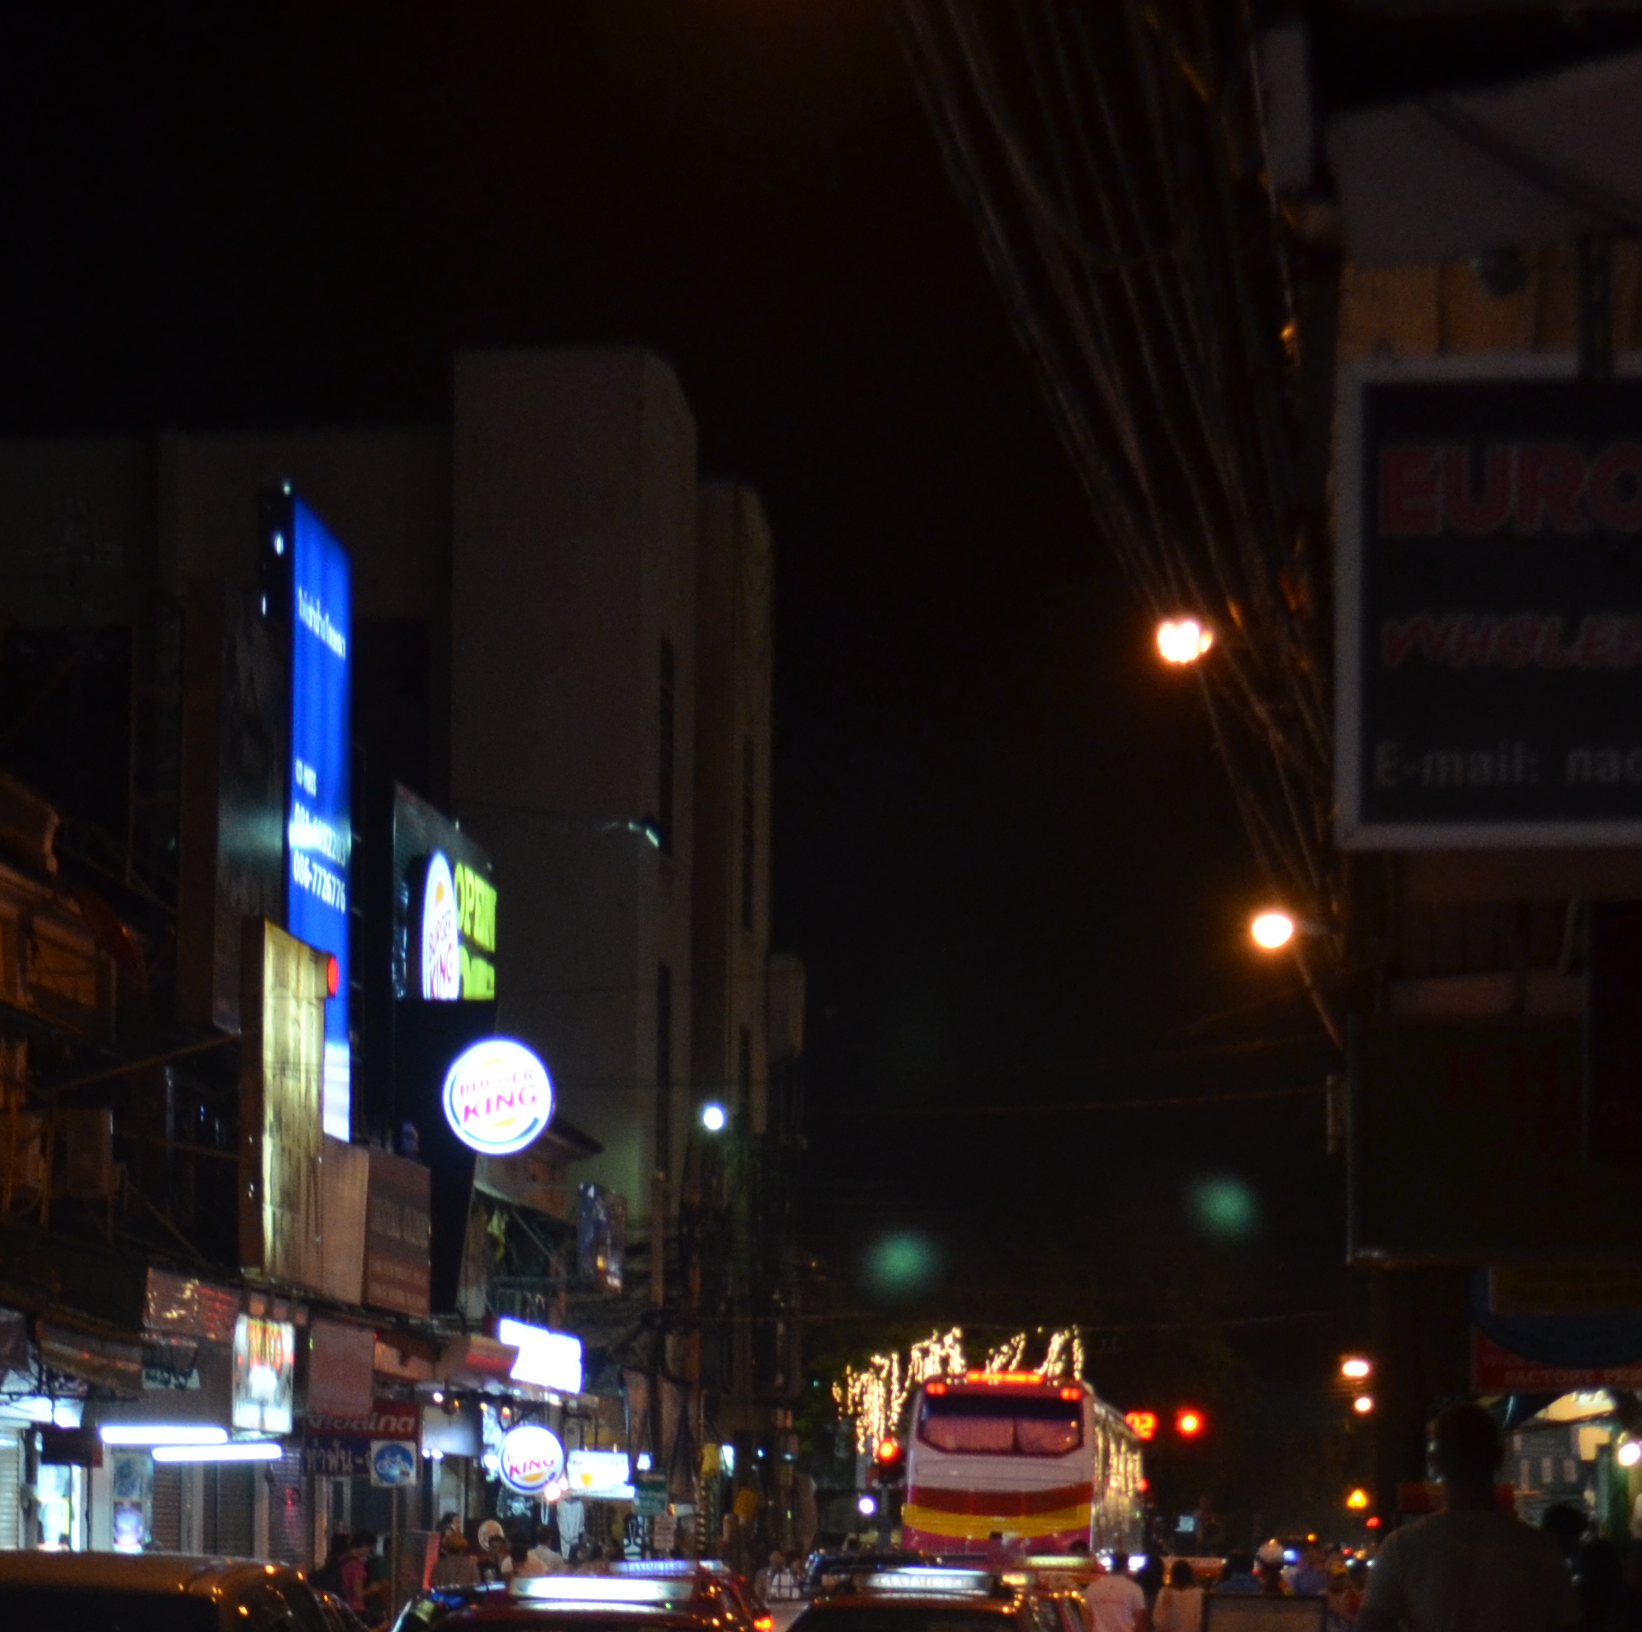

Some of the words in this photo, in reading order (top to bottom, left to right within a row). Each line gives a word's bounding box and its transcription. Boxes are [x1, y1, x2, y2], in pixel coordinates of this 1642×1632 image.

[1374, 738, 1541, 789] E-mail:
[454, 862, 496, 953] OPEN
[462, 1084, 537, 1124] KING
[508, 1457, 555, 1478] KING
